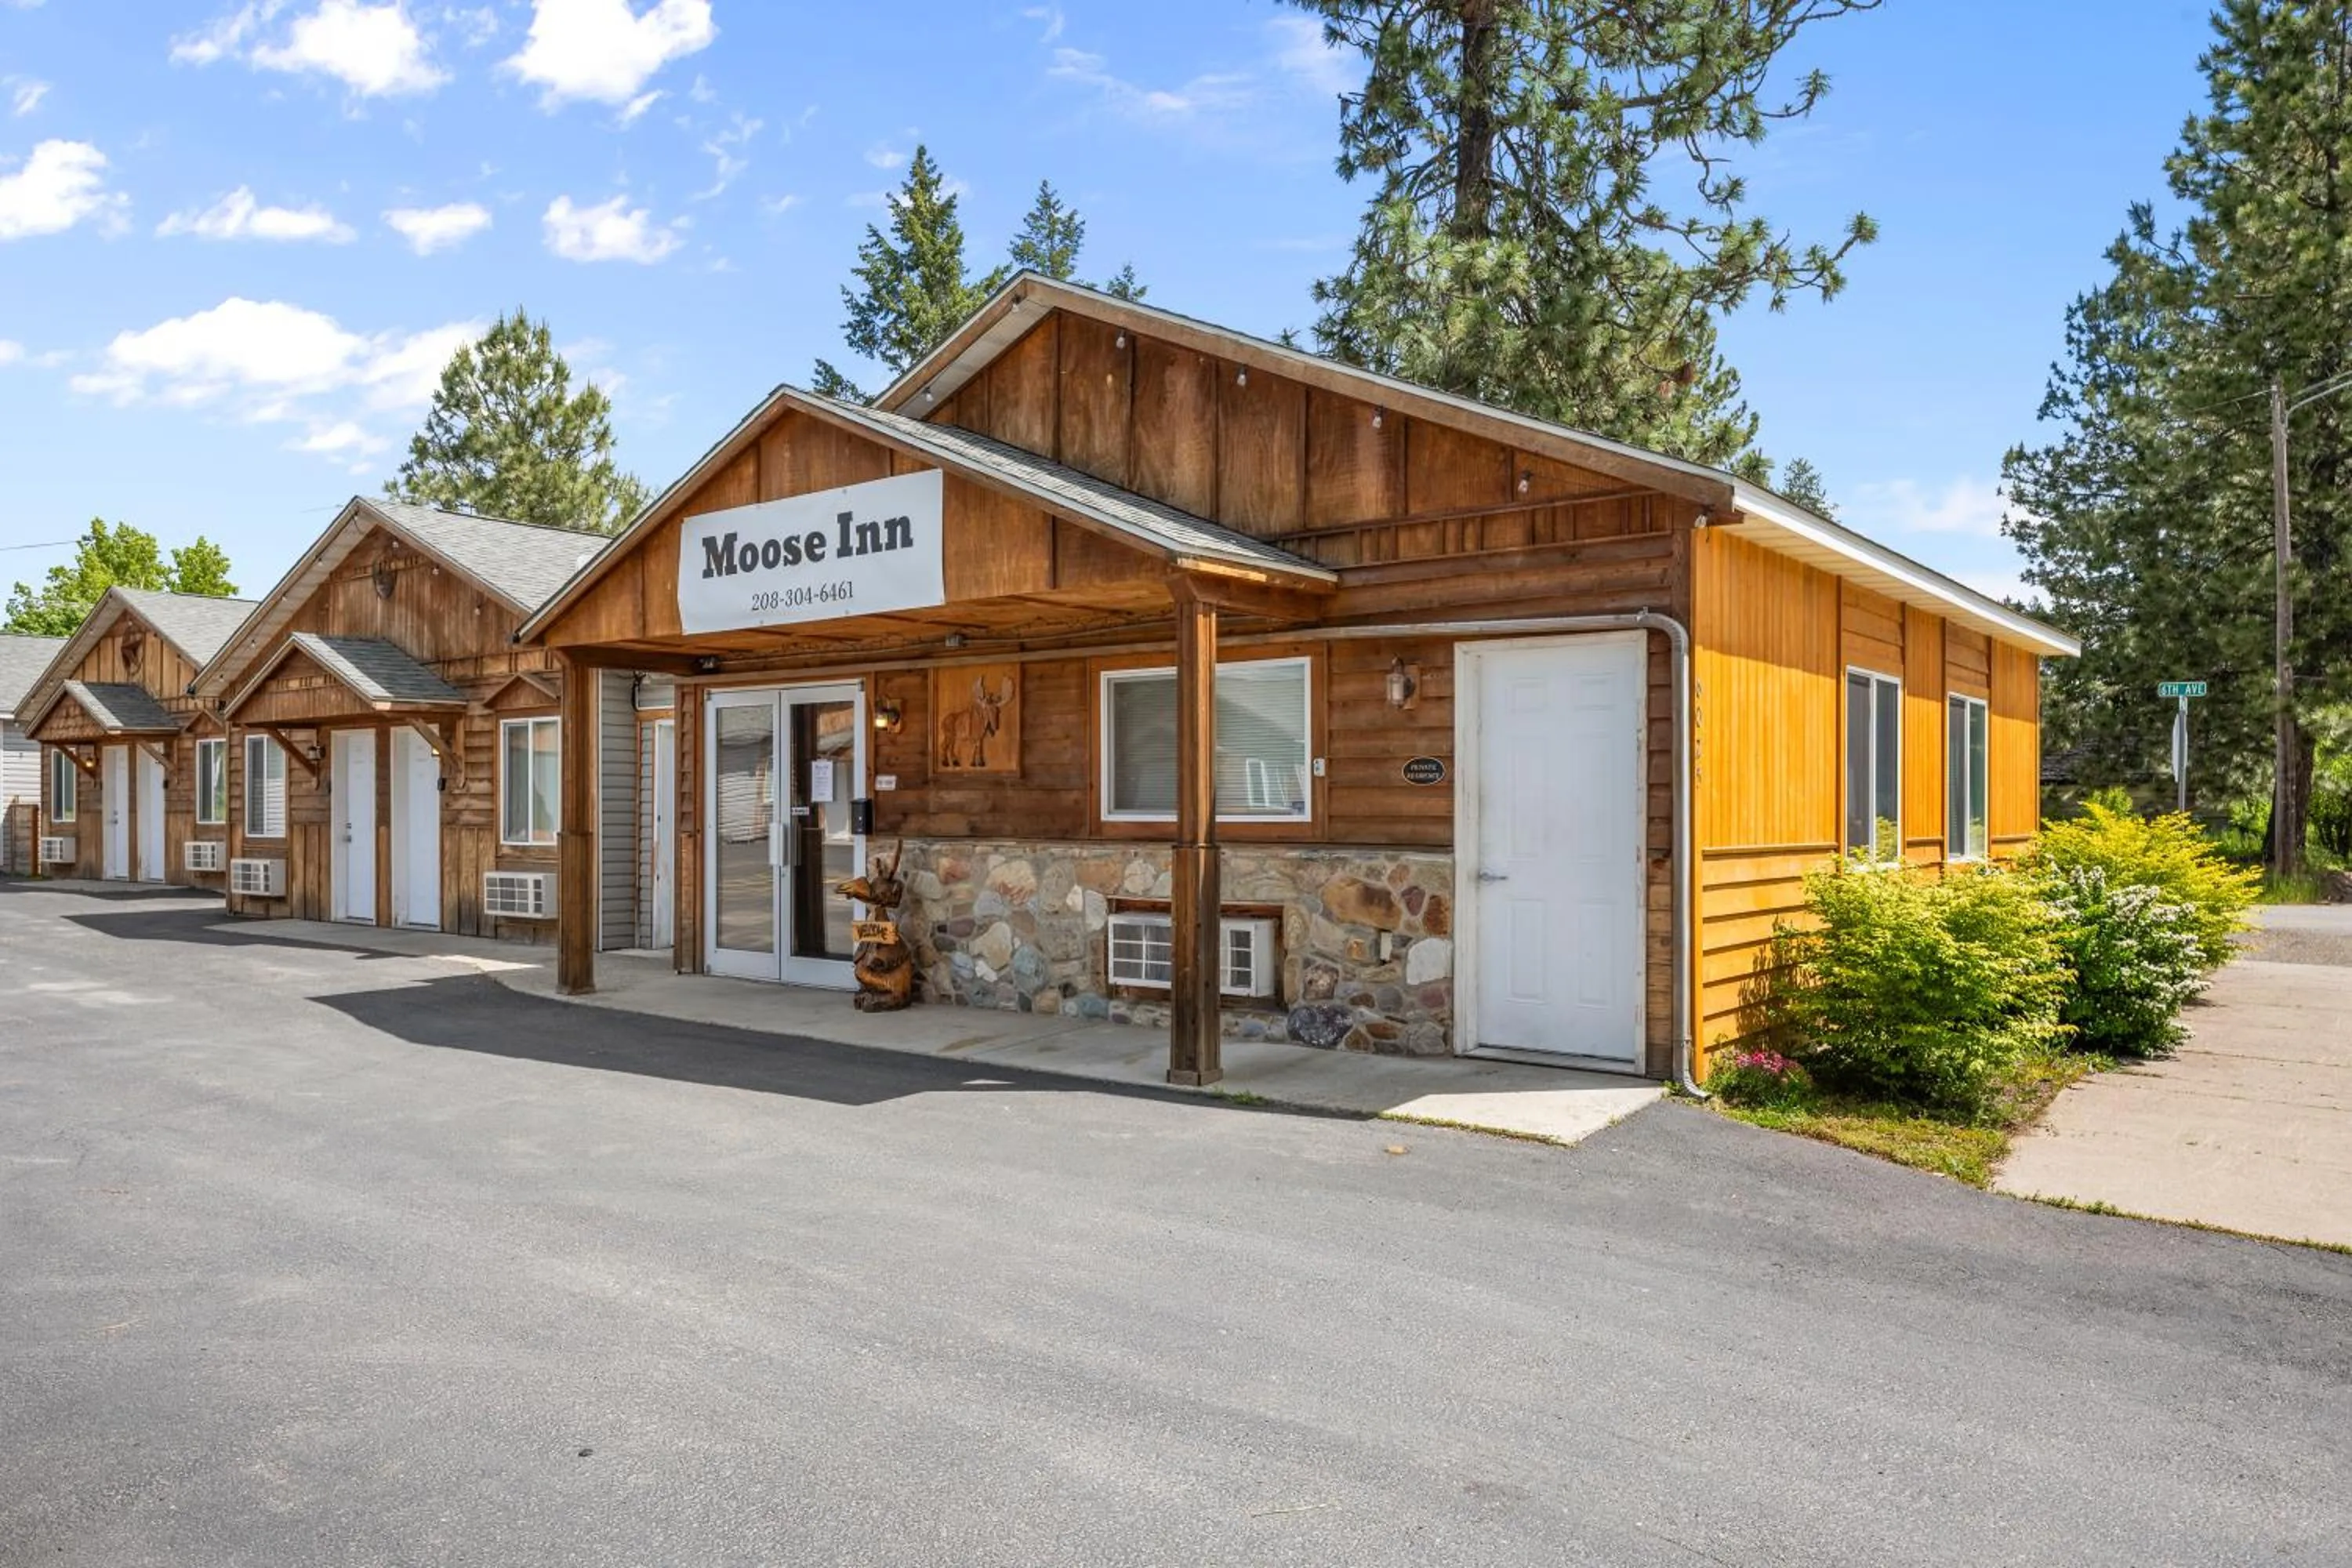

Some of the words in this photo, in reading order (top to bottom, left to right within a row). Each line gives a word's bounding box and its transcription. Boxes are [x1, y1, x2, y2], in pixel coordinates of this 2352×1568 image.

[702, 530, 827, 579] Moose
[836, 510, 914, 559] Inn
[751, 580, 855, 612] 208-304-6461
[2185, 683, 2203, 695] AVE
